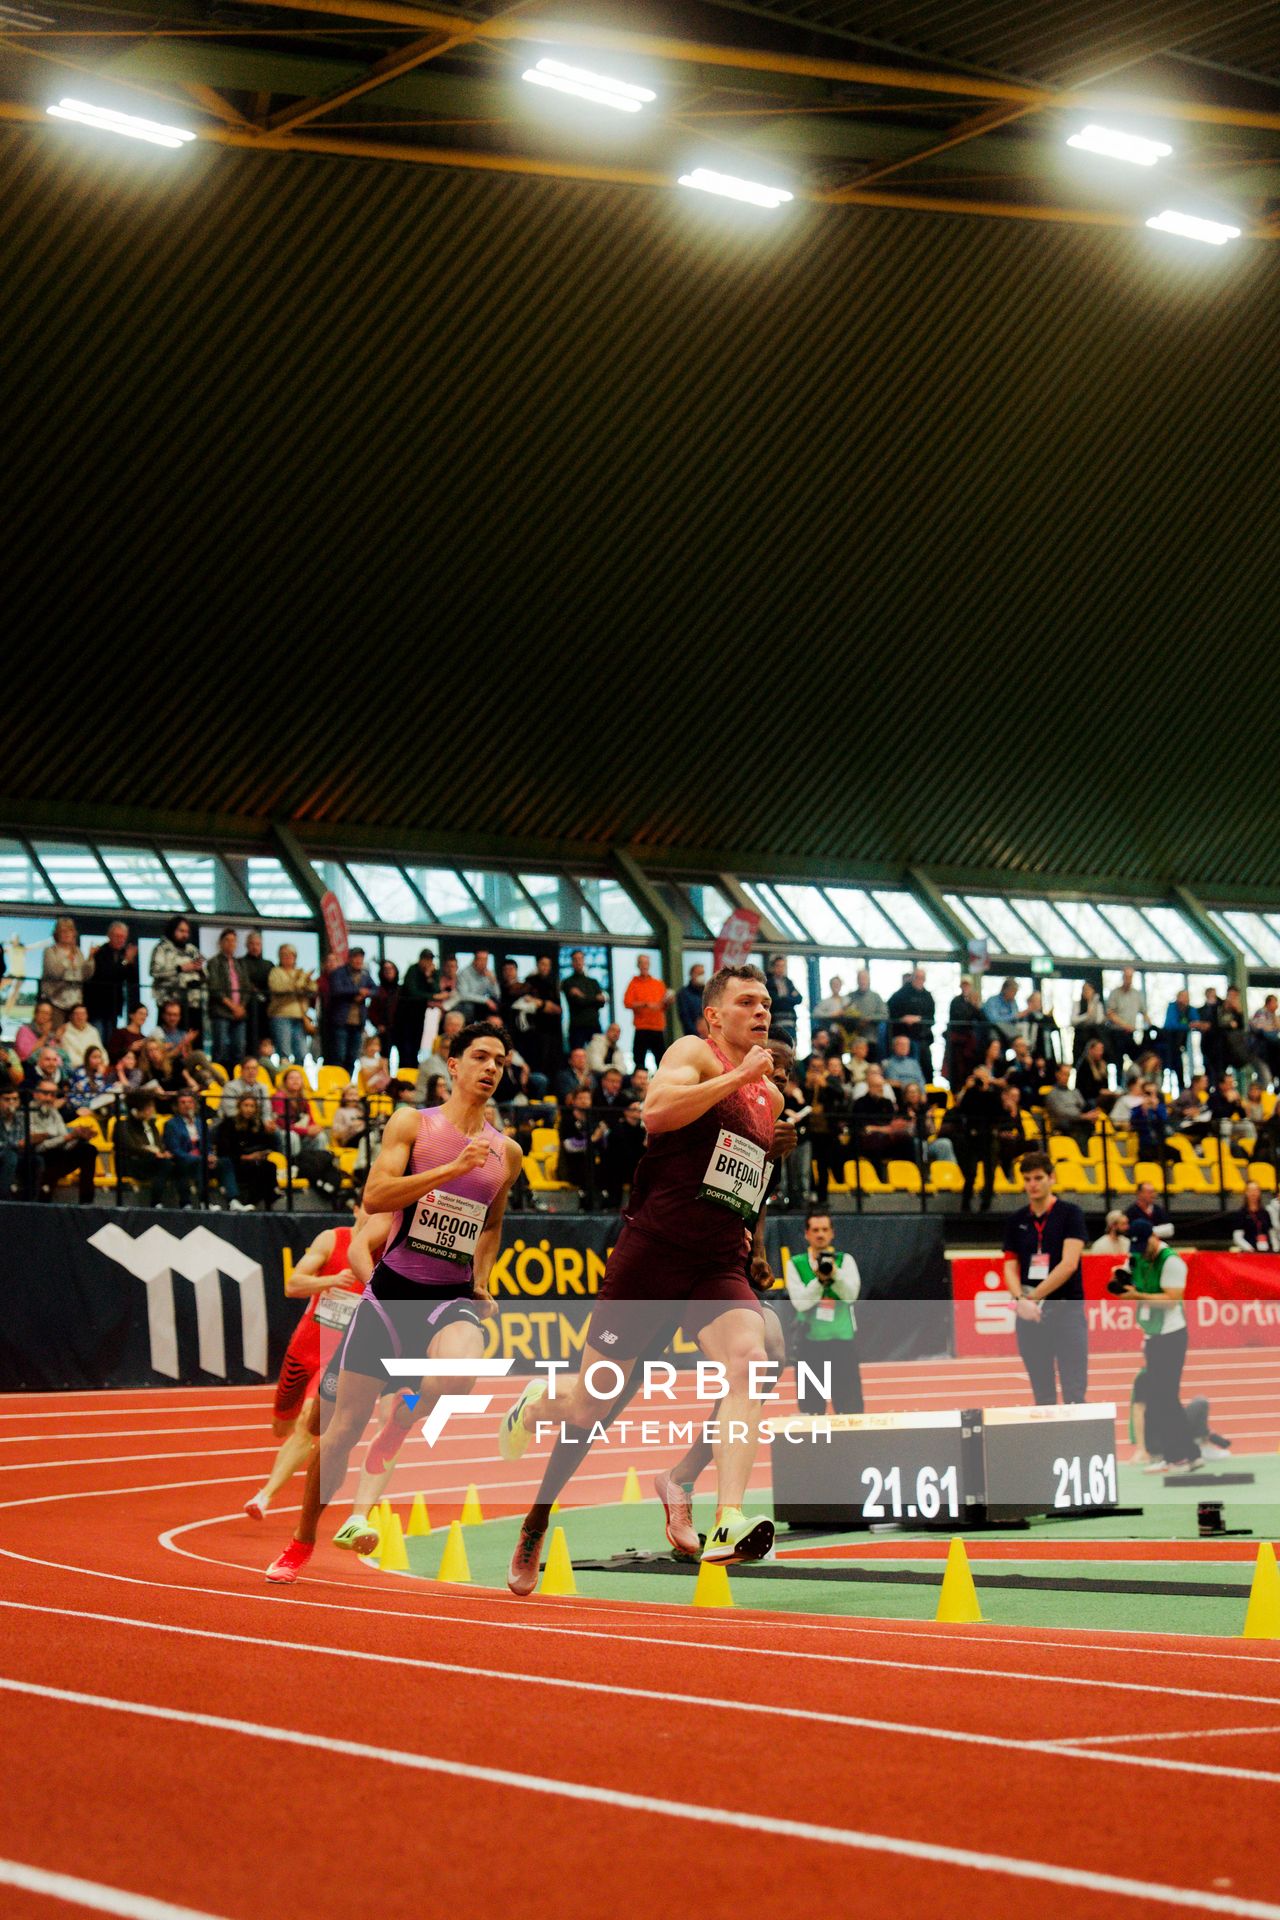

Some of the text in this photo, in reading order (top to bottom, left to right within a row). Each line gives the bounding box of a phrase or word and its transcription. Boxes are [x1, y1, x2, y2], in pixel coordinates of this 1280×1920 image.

[715, 1153, 760, 1189] BREDAU
[731, 1179, 743, 1196] 22
[437, 1200, 463, 1212] Dortmund
[455, 1198, 475, 1210] Meeting
[418, 1208, 479, 1241] SACOOR
[411, 1241, 457, 1260] DORTMUND 26
[435, 1231, 456, 1248] 159
[1088, 1298, 1141, 1331] rka
[861, 1465, 959, 1518] 21.61
[1053, 1453, 1117, 1508] 21.61
